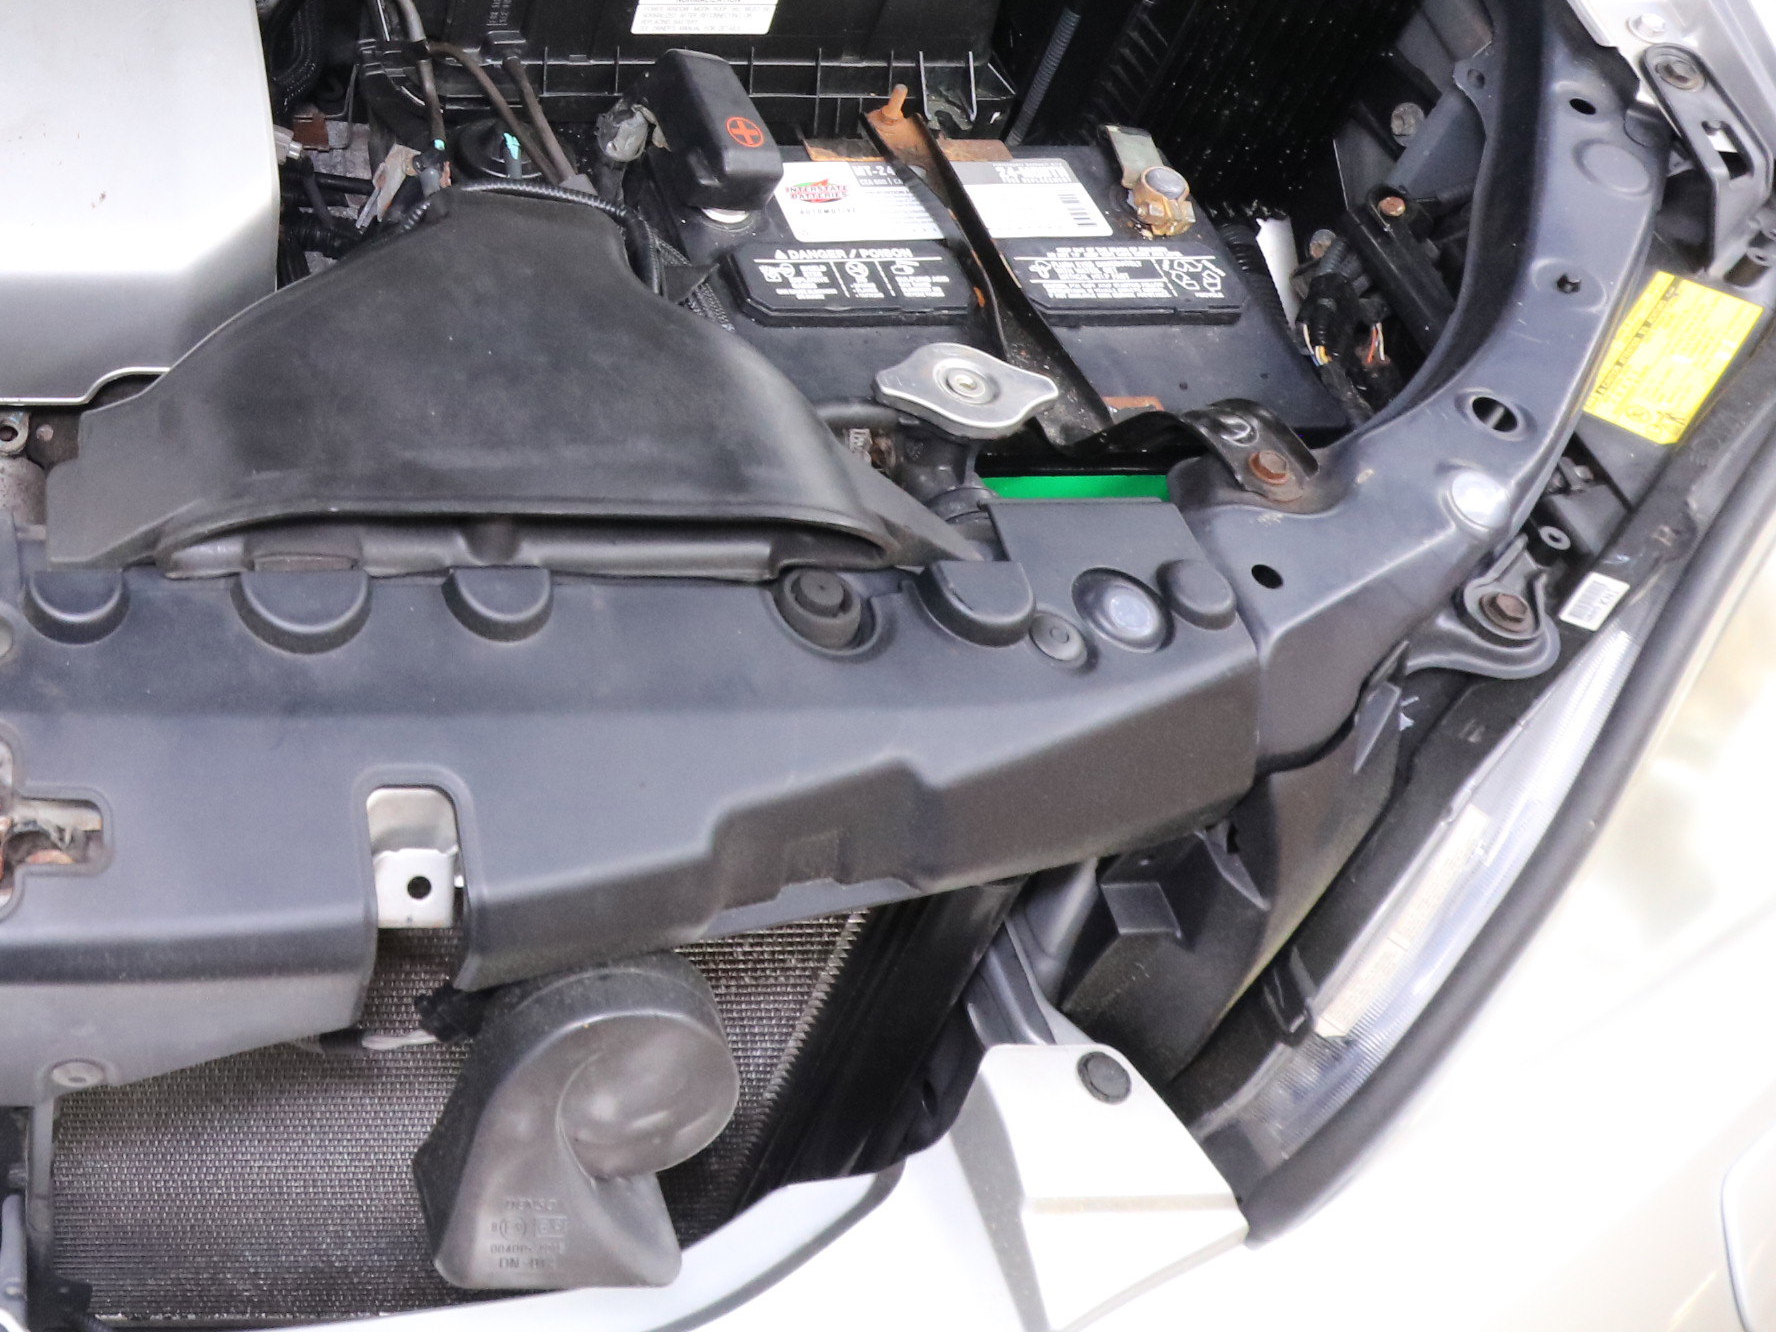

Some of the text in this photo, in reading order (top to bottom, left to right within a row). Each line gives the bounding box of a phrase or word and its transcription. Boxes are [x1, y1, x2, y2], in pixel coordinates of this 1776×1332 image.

[785, 184, 848, 193] INTERSTATE
[790, 191, 848, 199] BATTERIES
[787, 248, 848, 260] DANGER
[858, 247, 914, 259] POISON
